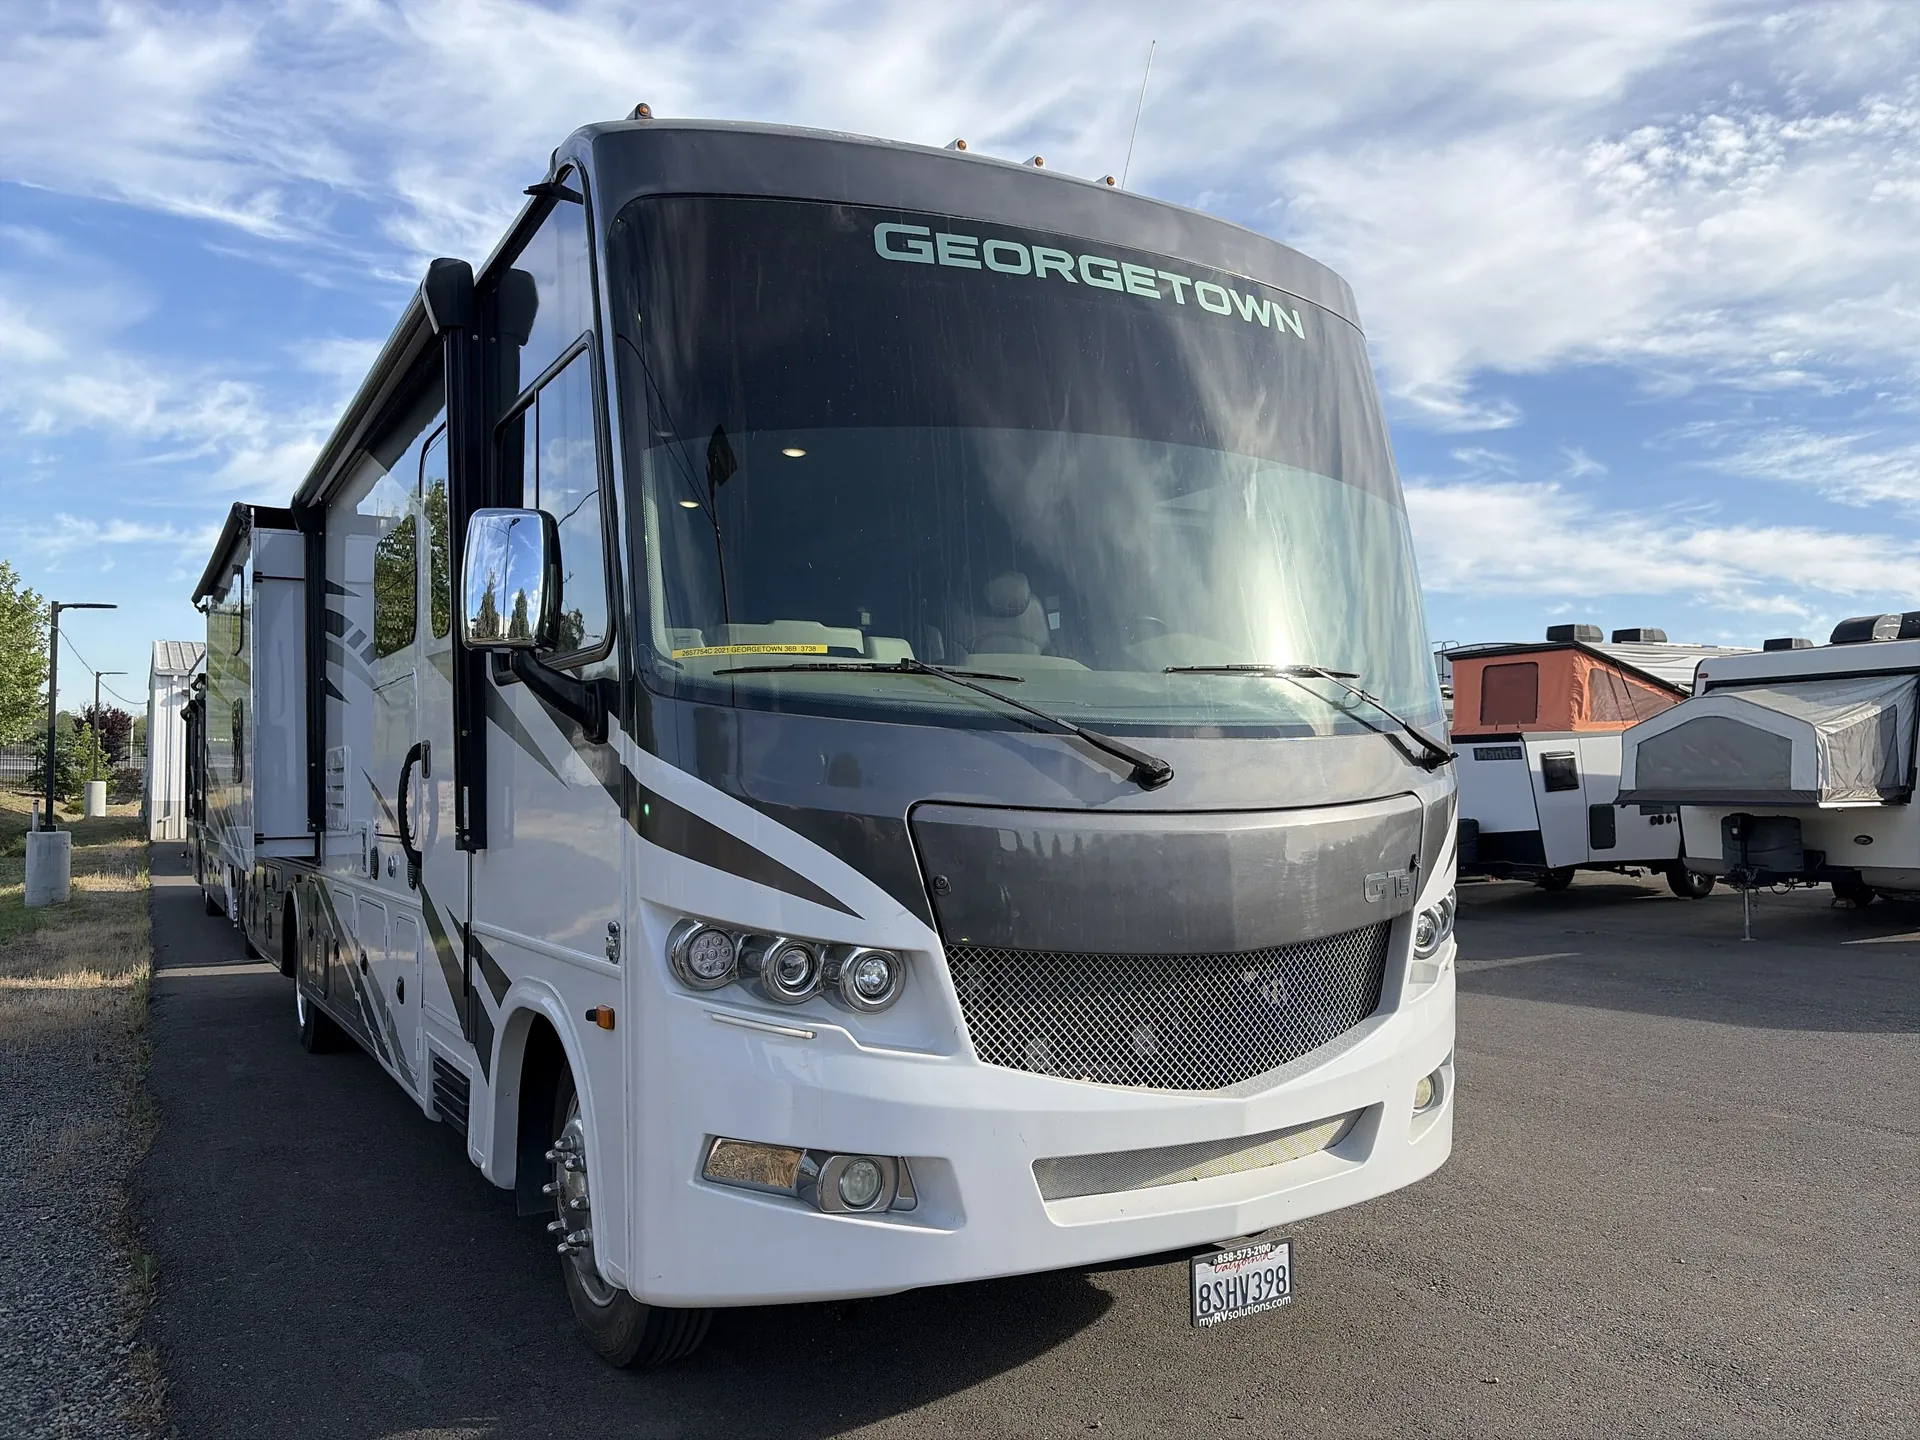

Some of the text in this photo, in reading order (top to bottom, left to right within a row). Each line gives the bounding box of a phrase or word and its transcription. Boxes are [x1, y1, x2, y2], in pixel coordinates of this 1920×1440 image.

[873, 222, 1306, 340] GEORGETOWN
[682, 648, 712, 657] 2657754C
[731, 645, 783, 654] GEORGETOWN
[1477, 748, 1519, 759] Mantis
[1217, 1243, 1271, 1264] 858-573-2100
[1199, 1265, 1287, 1314] 8SHV398
[1199, 1295, 1292, 1328] myRVsolutions.com
